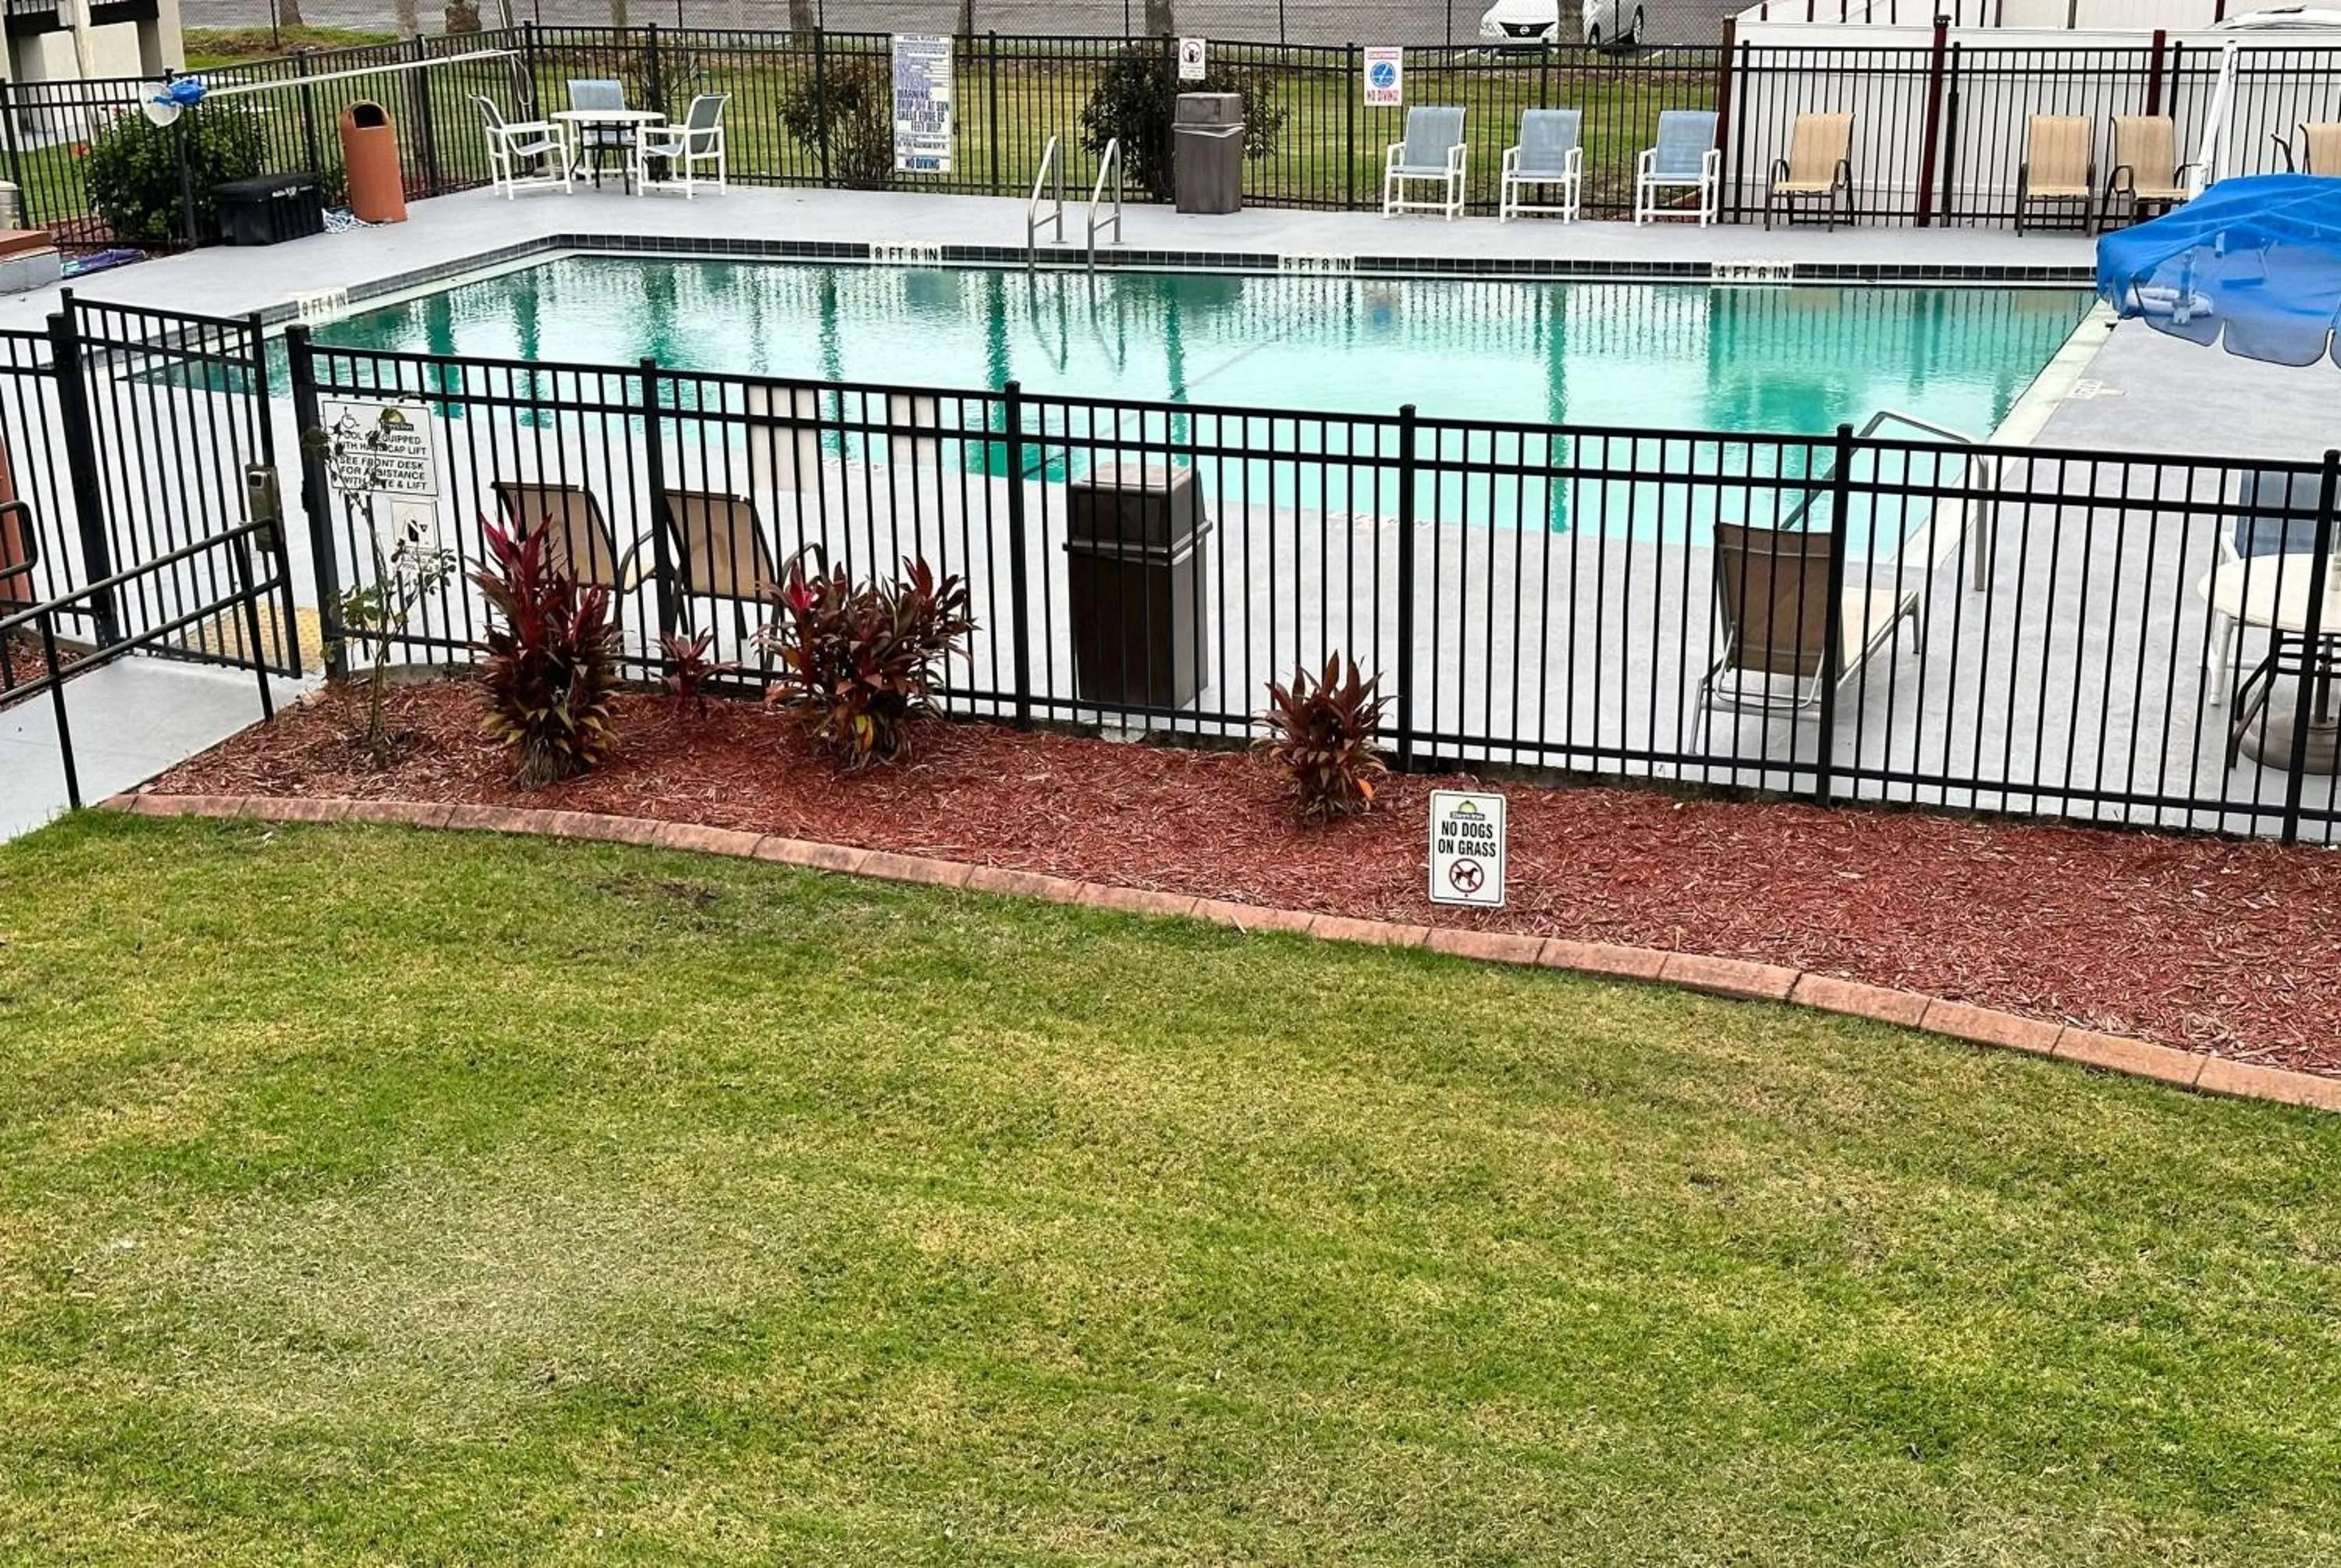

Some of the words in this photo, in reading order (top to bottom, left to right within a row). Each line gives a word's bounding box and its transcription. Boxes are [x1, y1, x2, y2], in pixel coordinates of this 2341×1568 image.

[937, 112, 945, 122] IS
[906, 158, 915, 169] NO
[916, 158, 940, 170] DIVING
[890, 247, 903, 260] FT
[924, 247, 936, 261] IN
[1298, 257, 1313, 270] FT
[1337, 258, 1350, 271] IN
[1733, 266, 1750, 278] FT
[1774, 266, 1789, 279] IN
[407, 446, 427, 456] LIFT
[340, 455, 359, 465] SEE
[361, 457, 395, 469] FRONT
[397, 460, 424, 470] DESK
[363, 467, 426, 481] ASISTANCE
[407, 481, 428, 490] LIFT
[1441, 821, 1457, 836] NO
[1462, 822, 1494, 839] DOGS
[1438, 839, 1454, 854] ON
[1458, 840, 1496, 857] GRASS
